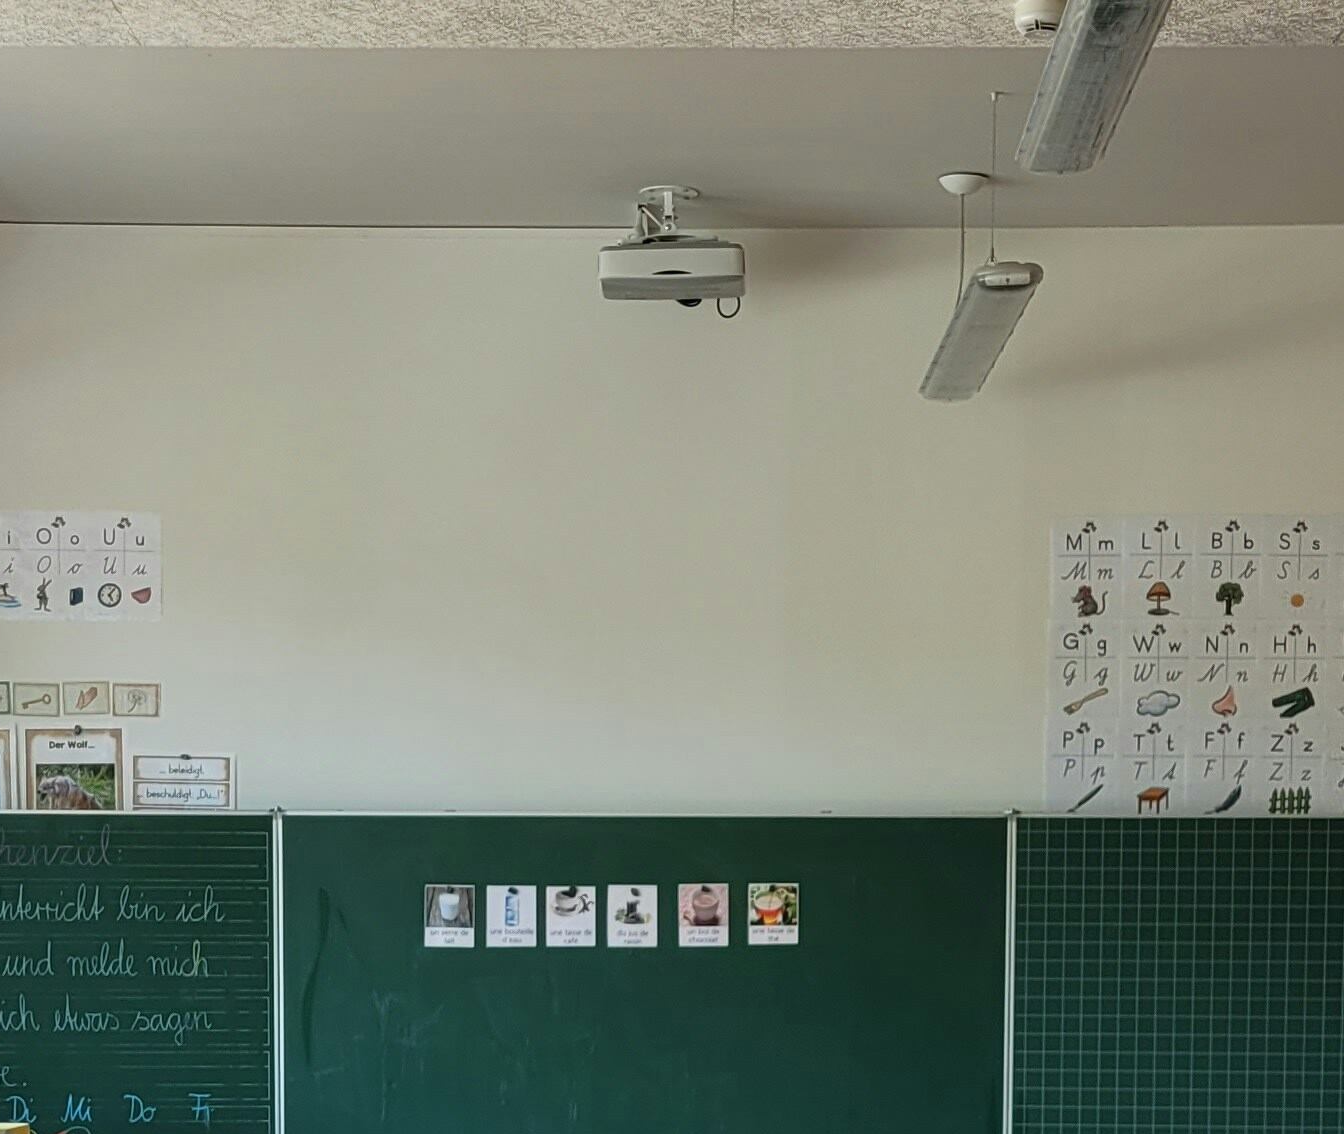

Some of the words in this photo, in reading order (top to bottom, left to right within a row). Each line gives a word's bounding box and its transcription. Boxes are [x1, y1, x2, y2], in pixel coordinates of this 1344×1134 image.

[7, 531, 11, 545] i
[36, 528, 52, 545] O
[70, 535, 80, 545] o
[103, 529, 115, 546] U
[135, 535, 145, 547] u
[1066, 534, 1083, 551] M
[1098, 540, 1114, 551] m
[1141, 534, 1152, 550] L
[1211, 533, 1223, 550] B
[1243, 533, 1254, 550] b
[1279, 534, 1291, 550] S
[1312, 540, 1321, 551] s
[36, 556, 52, 574] O
[103, 557, 117, 574] U
[131, 564, 148, 576] u
[1061, 563, 1089, 581] M
[1097, 568, 1114, 580] m
[1138, 560, 1154, 580] L
[1211, 560, 1223, 580] B
[1239, 560, 1256, 580] b
[1277, 561, 1291, 580] S
[1062, 633, 1079, 652] G
[1097, 640, 1107, 656] g
[1133, 636, 1155, 653] W
[1168, 640, 1182, 653] w
[1205, 636, 1219, 653] N
[1239, 640, 1249, 653] n
[1273, 637, 1287, 653] H
[1307, 637, 1317, 653] h
[1063, 663, 1078, 686] G
[1094, 665, 1109, 685] g
[1133, 663, 1154, 683] W
[1166, 669, 1183, 682] w
[1198, 664, 1219, 683] N
[1236, 669, 1249, 683] n
[1272, 664, 1288, 683] H
[1302, 663, 1319, 683] h
[49, 741, 65, 749] Der
[1062, 731, 1074, 749] P
[1094, 739, 1105, 755] p
[1133, 734, 1145, 752] T
[1166, 734, 1175, 752] t
[1204, 732, 1215, 750] F
[1236, 732, 1245, 750] f
[1271, 735, 1284, 752] Z
[1303, 740, 1313, 752] z
[1064, 759, 1076, 777] P
[1091, 765, 1106, 783] p
[1134, 761, 1148, 780] T
[1204, 759, 1217, 777] F
[1269, 762, 1283, 780] Z
[117, 885, 166, 921] bin
[175, 885, 225, 923] ich
[2, 940, 55, 977] und
[67, 939, 139, 977] melde
[53, 994, 120, 1032] etwas
[131, 1011, 212, 1046] sagen
[6, 1096, 37, 1122] Di
[60, 1094, 92, 1122] Mi
[124, 1095, 156, 1123] Do
